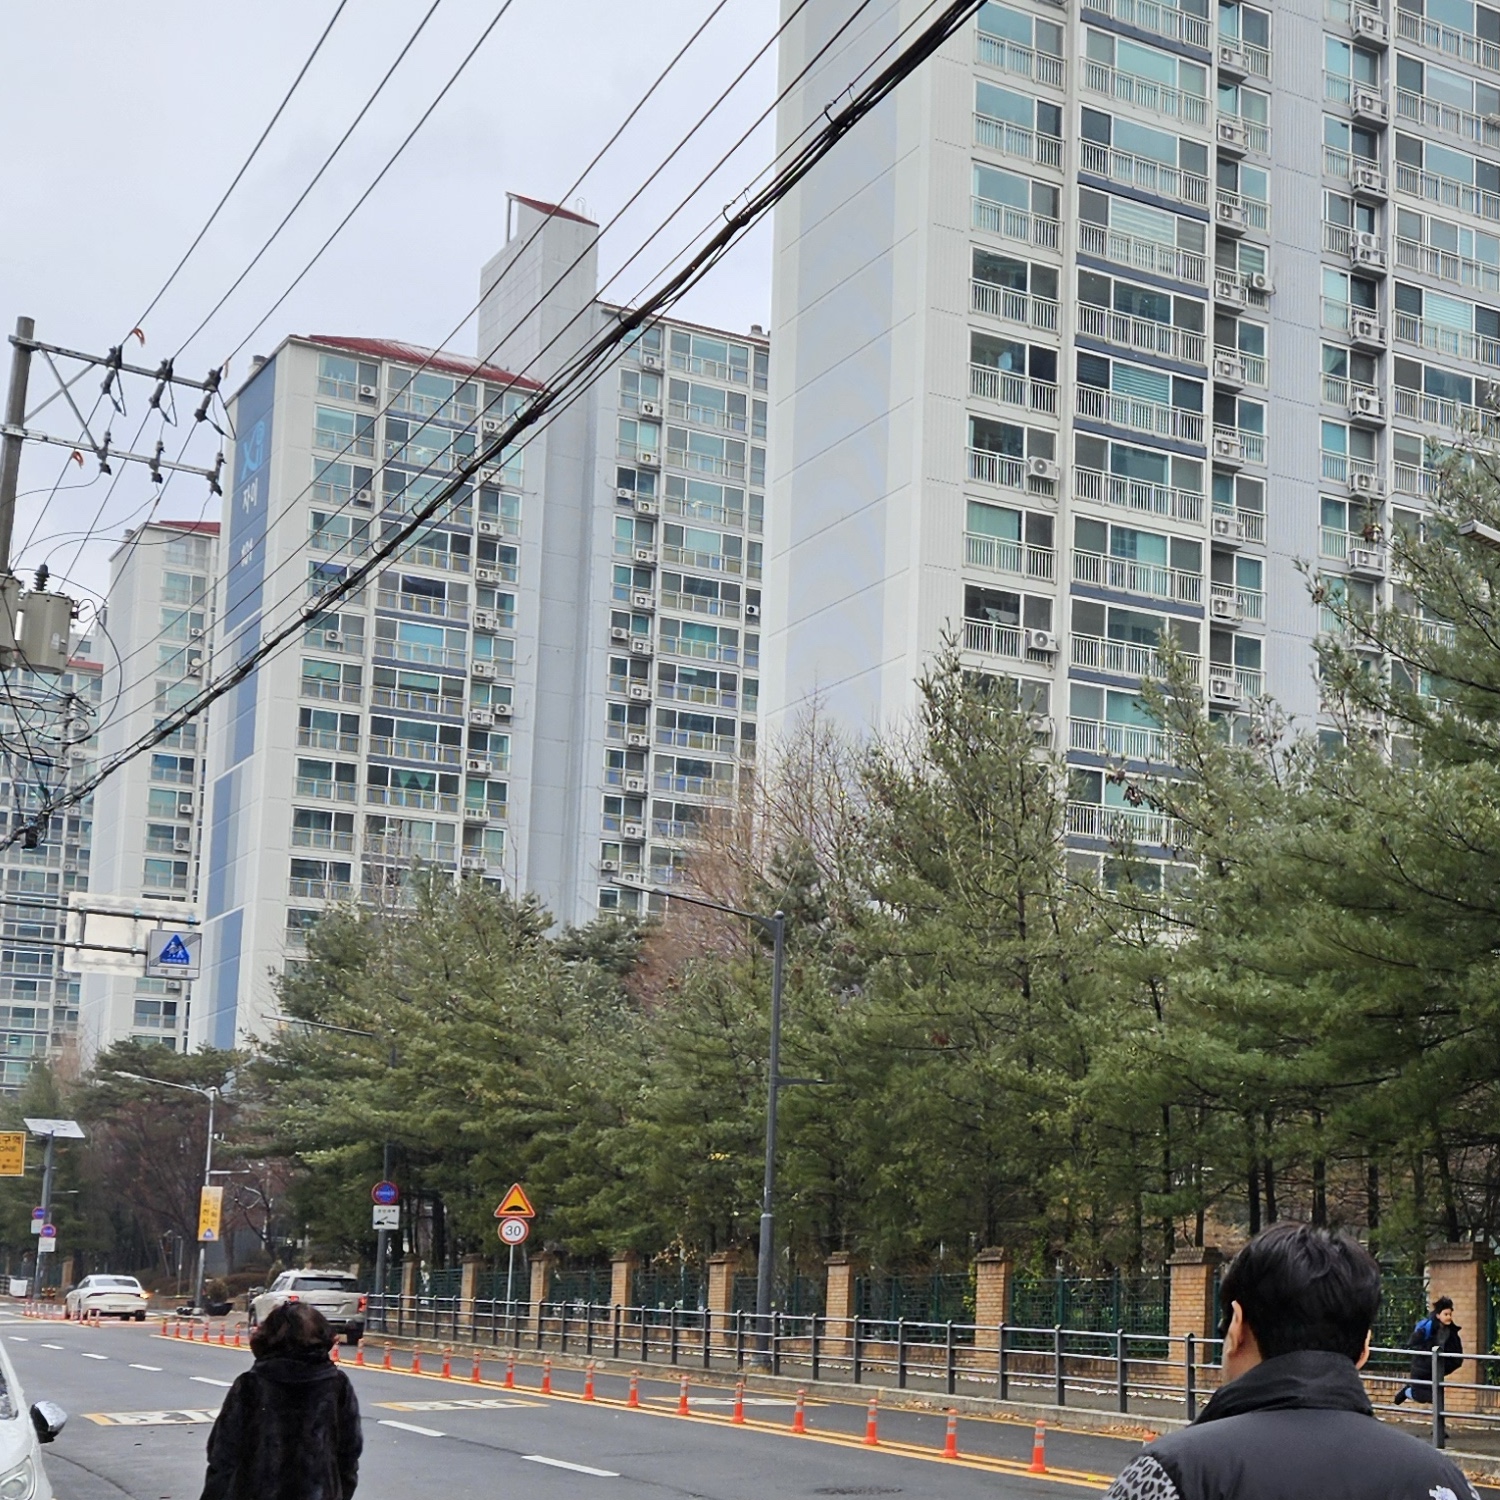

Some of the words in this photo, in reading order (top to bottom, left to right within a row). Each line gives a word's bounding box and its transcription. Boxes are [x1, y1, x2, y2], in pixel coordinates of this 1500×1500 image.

[242, 477, 259, 514] 자이
[0, 1135, 21, 1144] 구역
[505, 1225, 522, 1236] 30
